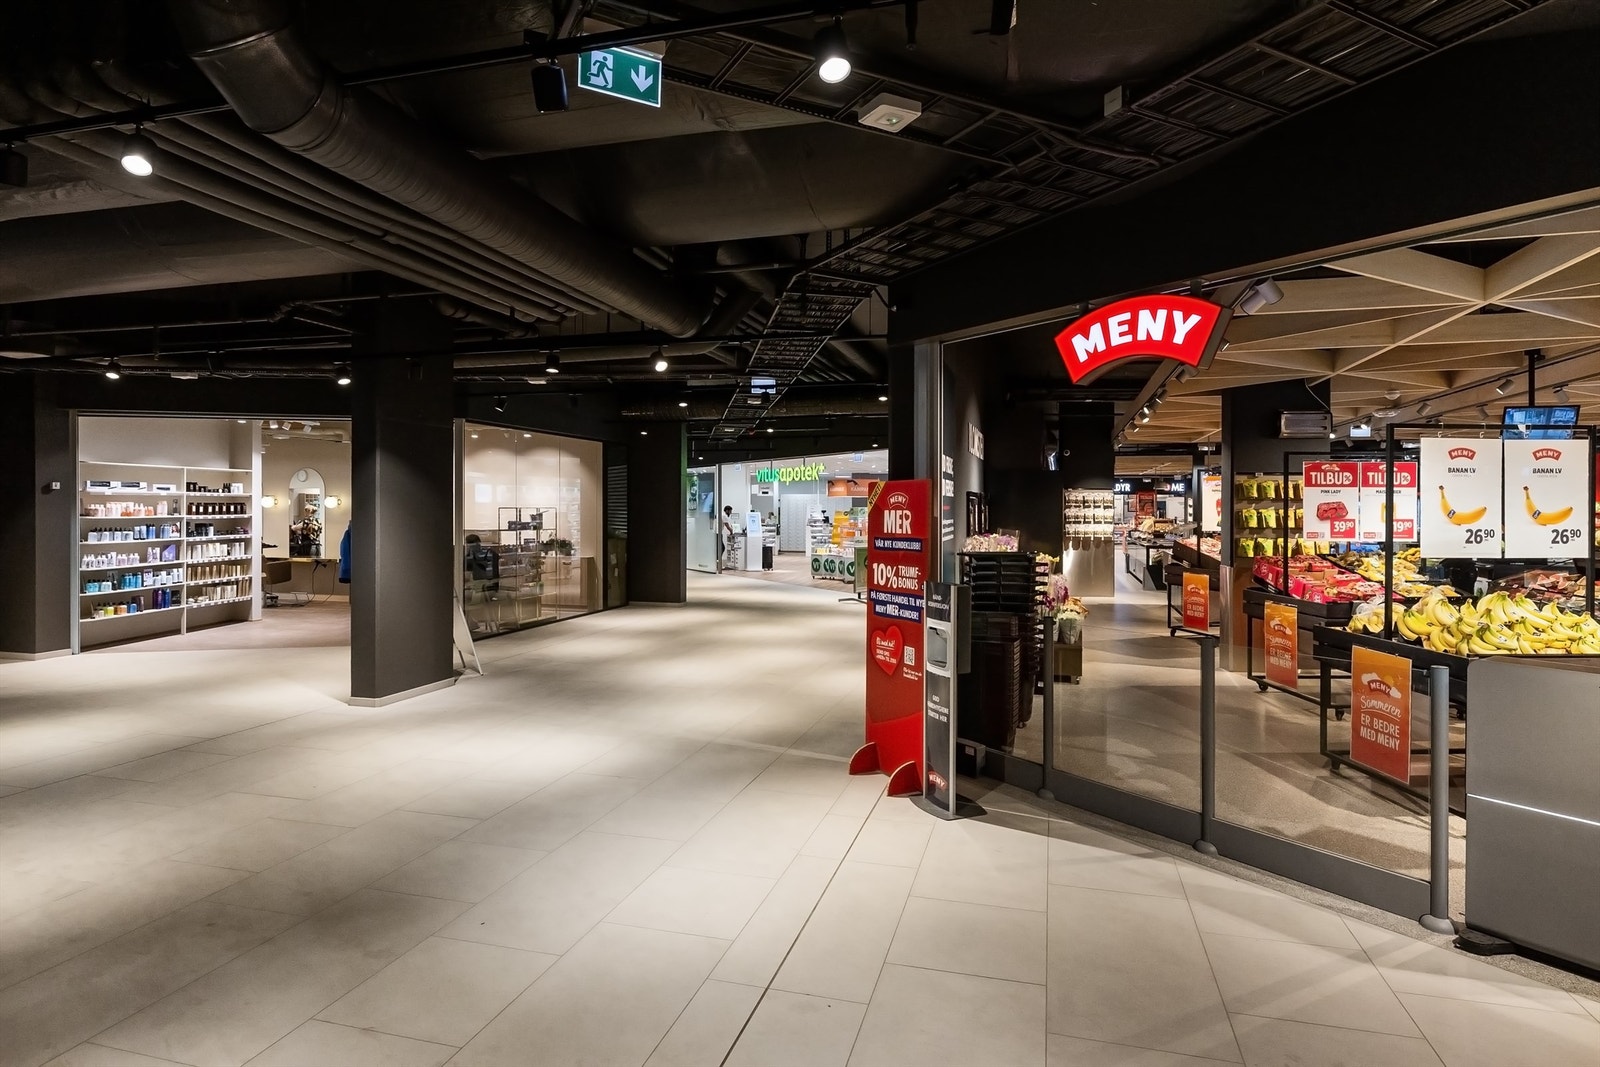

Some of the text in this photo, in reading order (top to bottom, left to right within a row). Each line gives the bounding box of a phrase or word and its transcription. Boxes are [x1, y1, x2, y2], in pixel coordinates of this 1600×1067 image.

[1071, 309, 1202, 364] MENY
[1309, 472, 1353, 485] TILBUD
[1366, 472, 1411, 485] TILUD
[889, 495, 907, 504] MENY
[883, 509, 912, 534] MER
[873, 563, 898, 589] 10%
[898, 566, 921, 578] TRUMF-
[898, 577, 919, 590] BONUS
[870, 590, 876, 599] PÅ
[892, 595, 909, 605] HANDEL
[1370, 682, 1391, 694] MENY
[1360, 695, 1402, 718] Sommeren
[1361, 713, 1400, 738] ER BEDRE
[1360, 726, 1400, 751] MED MENY
[928, 774, 945, 788] MENY
